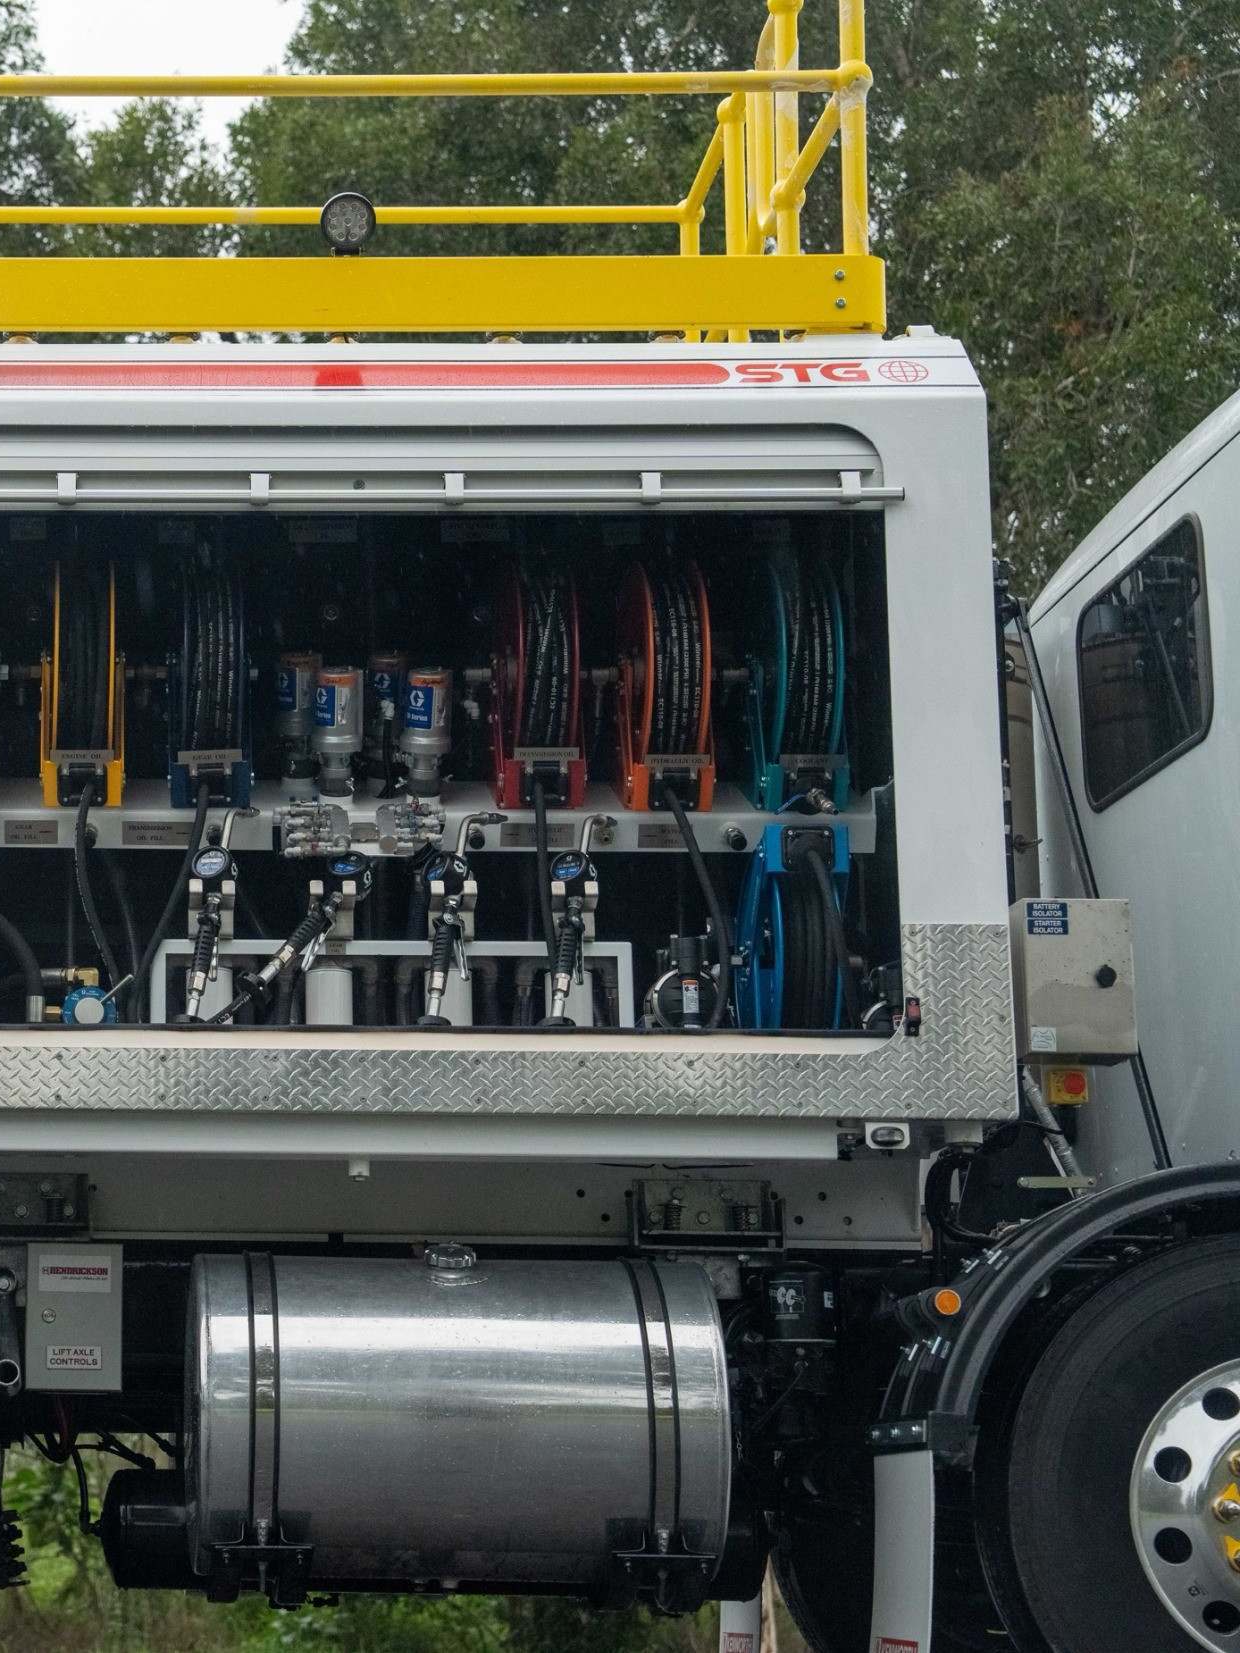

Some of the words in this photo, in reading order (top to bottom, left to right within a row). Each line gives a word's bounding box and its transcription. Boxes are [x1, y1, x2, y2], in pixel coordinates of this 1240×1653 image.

[734, 362, 871, 383] STG
[49, 1267, 108, 1275] HENDRICKSON
[53, 1348, 72, 1356] LIFT
[49, 1358, 98, 1366] CONTROLS
